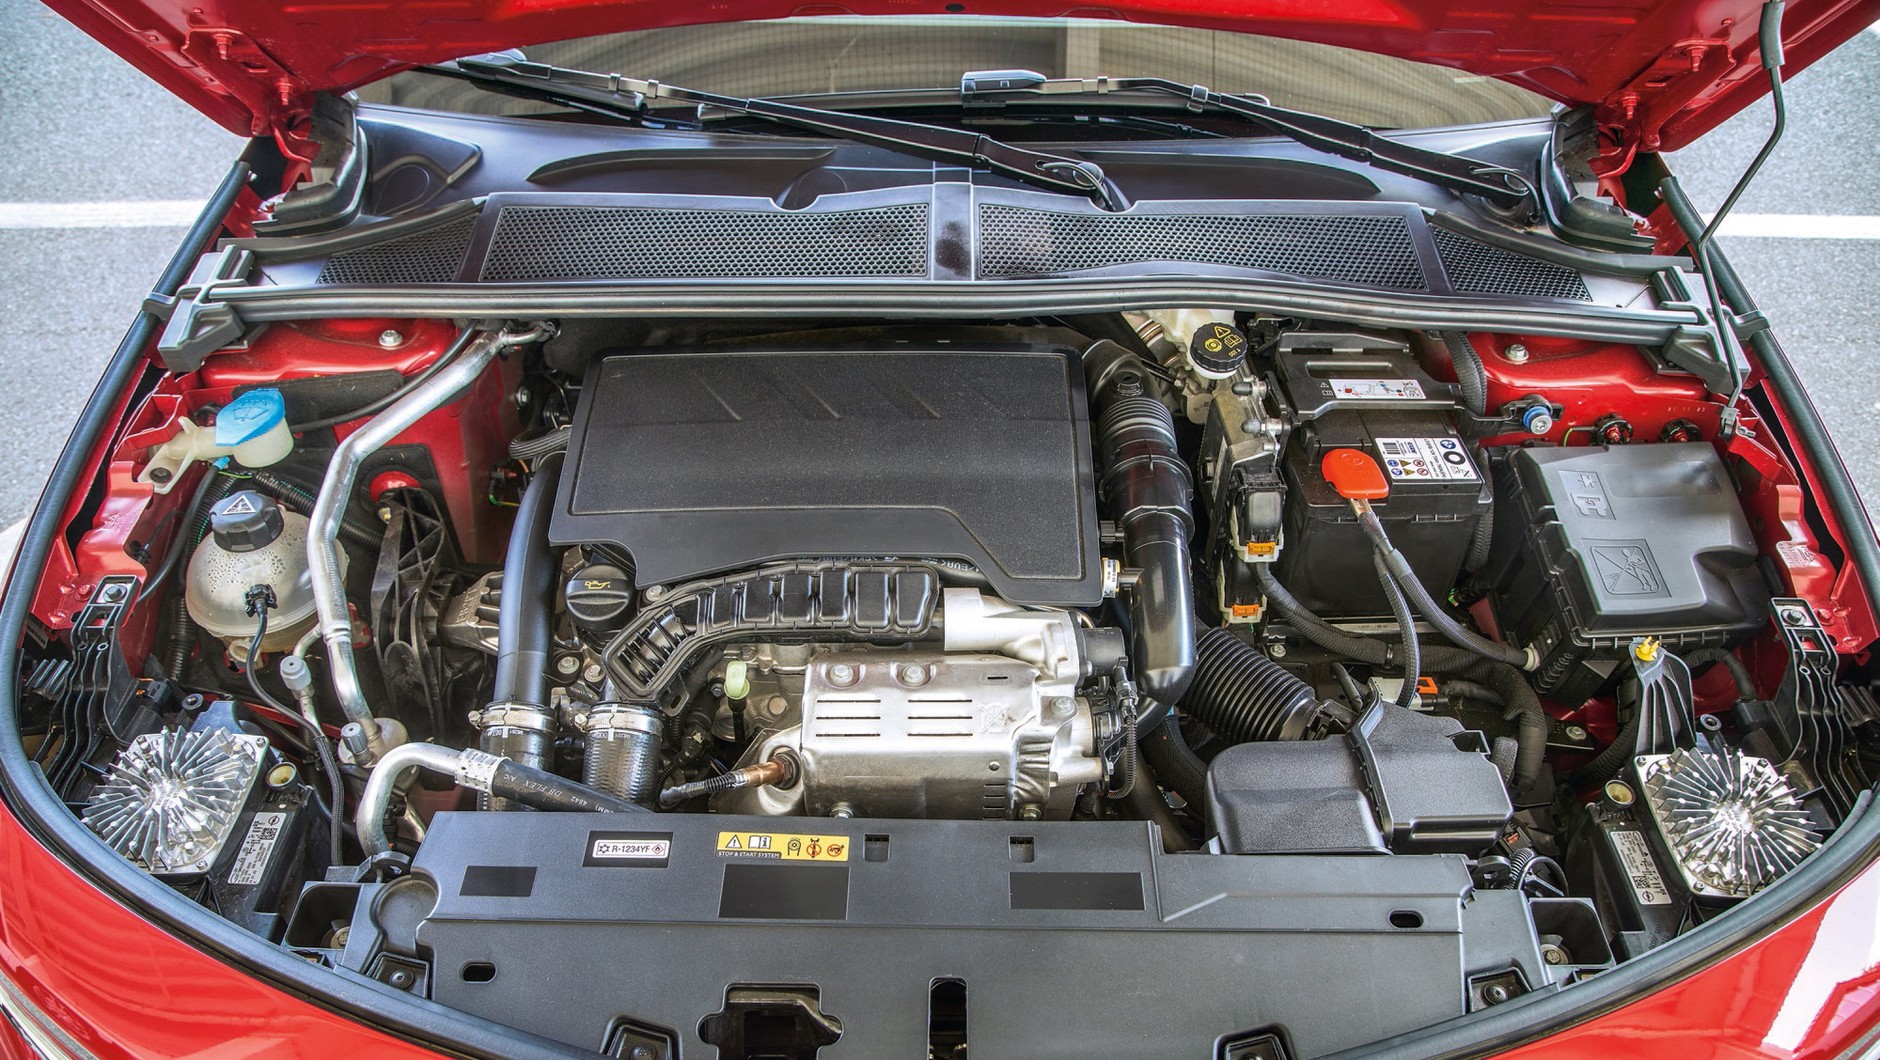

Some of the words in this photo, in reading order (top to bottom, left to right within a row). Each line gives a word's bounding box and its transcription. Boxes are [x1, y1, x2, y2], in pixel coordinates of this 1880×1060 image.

[503, 773, 517, 782] A/C
[524, 780, 548, 793] FLEX
[548, 788, 563, 798] DB
[570, 795, 588, 806] 4842
[612, 844, 651, 854] R-1234YF
